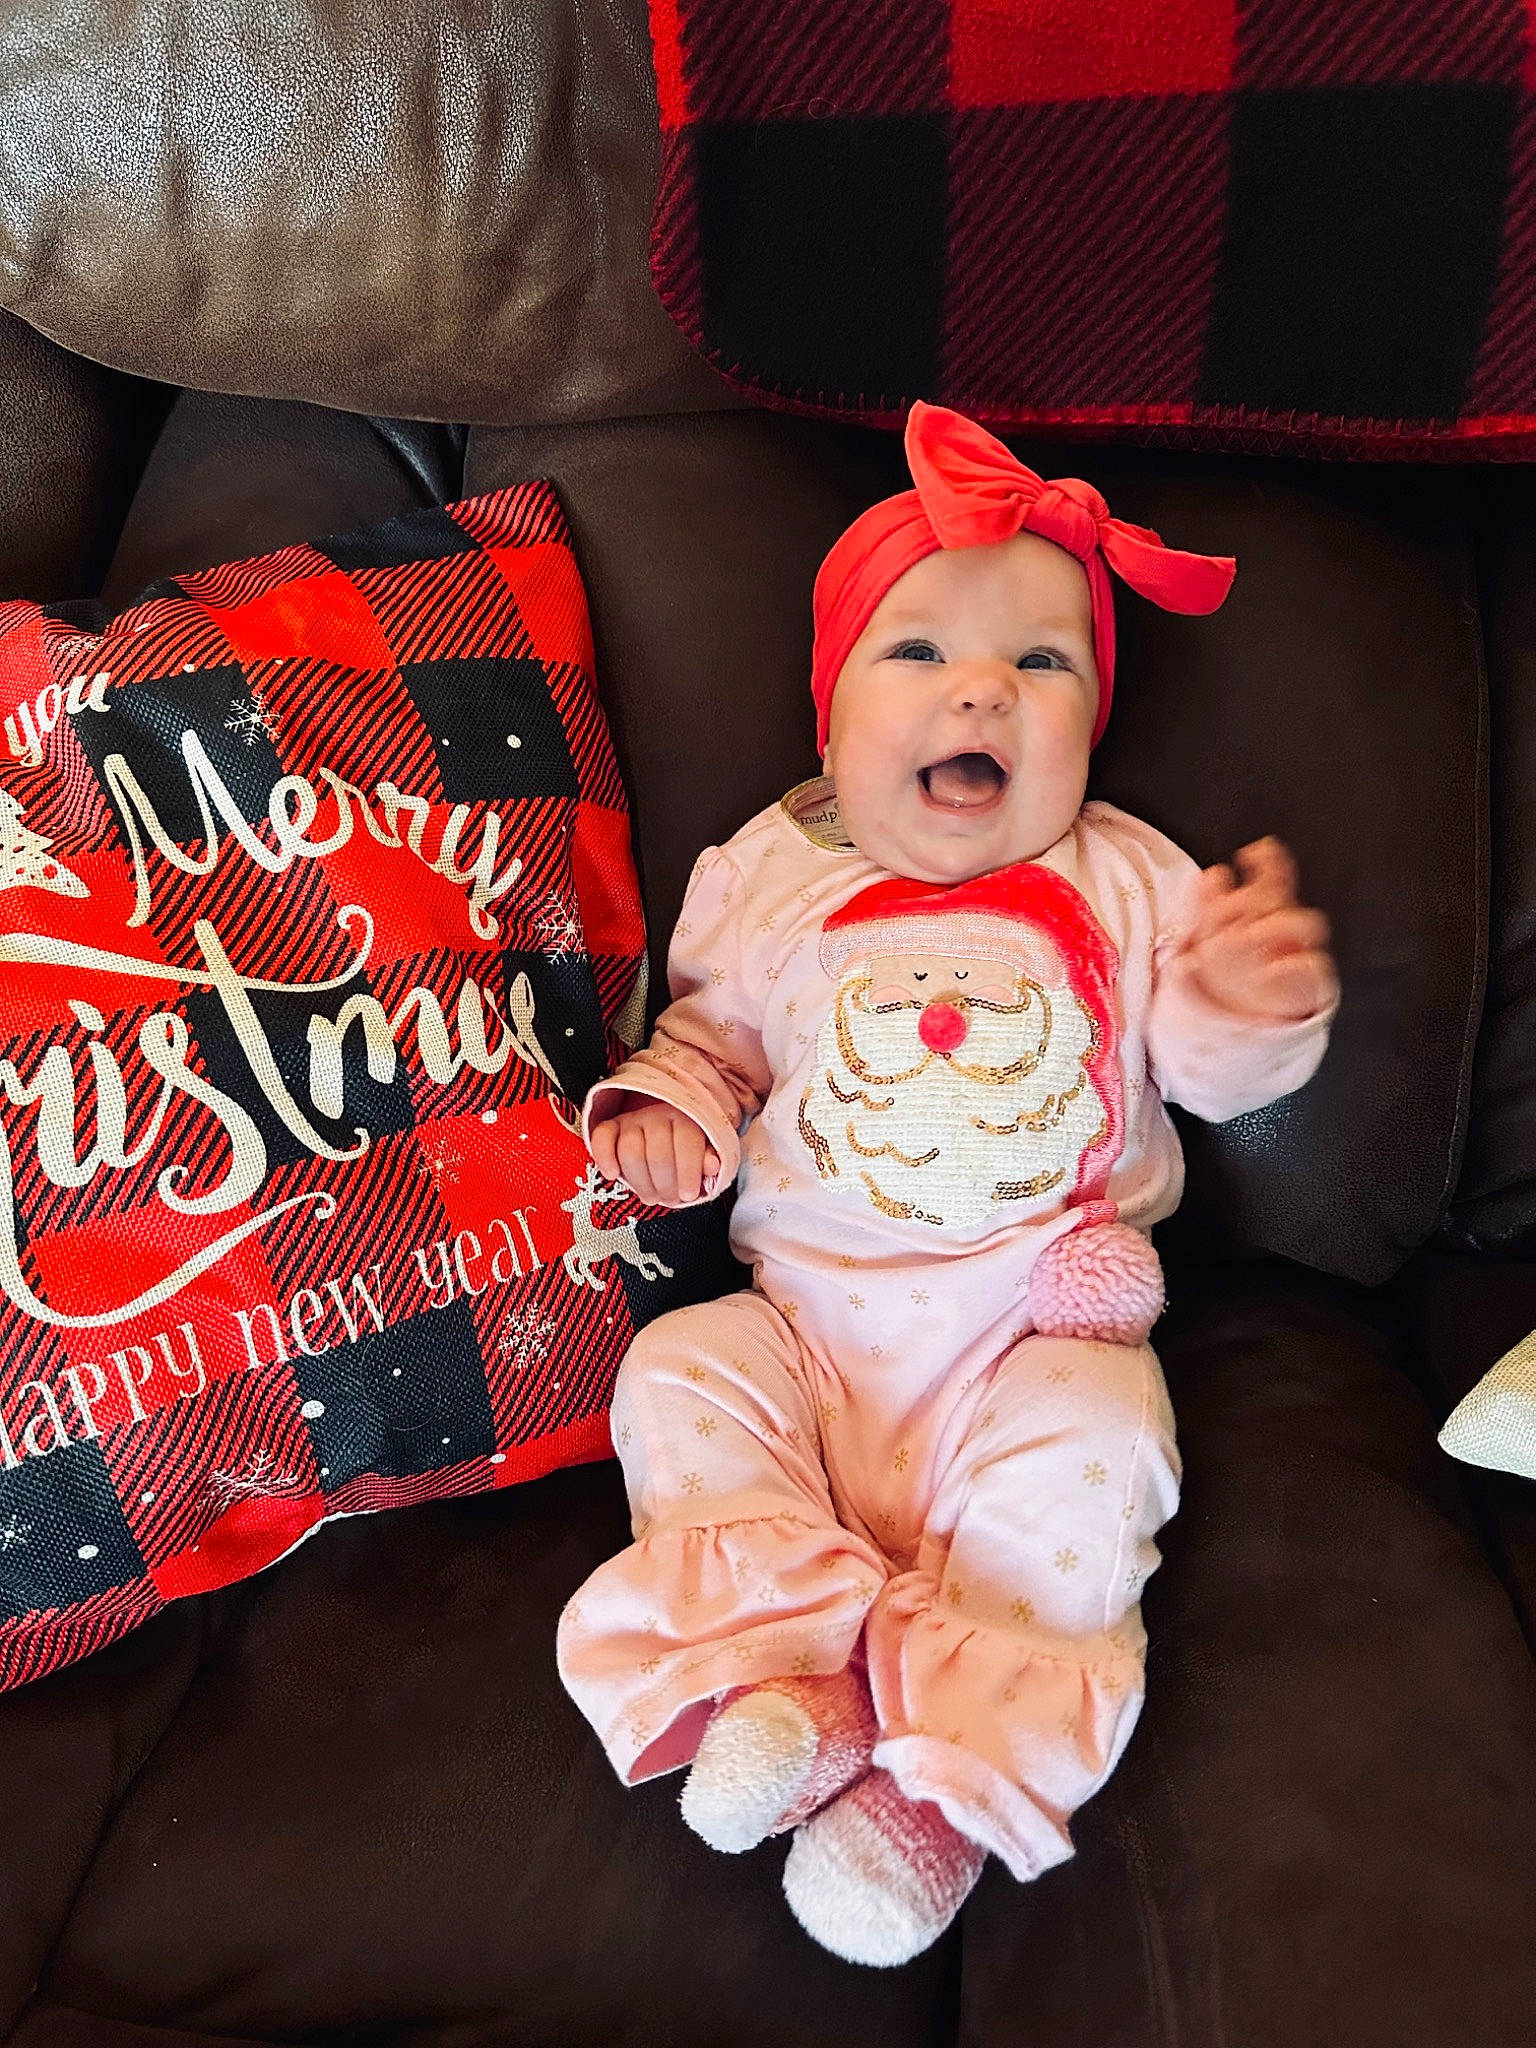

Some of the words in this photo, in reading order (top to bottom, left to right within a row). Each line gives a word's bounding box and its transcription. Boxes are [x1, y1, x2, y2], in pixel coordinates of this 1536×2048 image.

[3, 672, 112, 767] you
[104, 729, 522, 940] Merry
[0, 905, 579, 1322] ristmas
[233, 1265, 384, 1370] new
[411, 1205, 545, 1309] year
